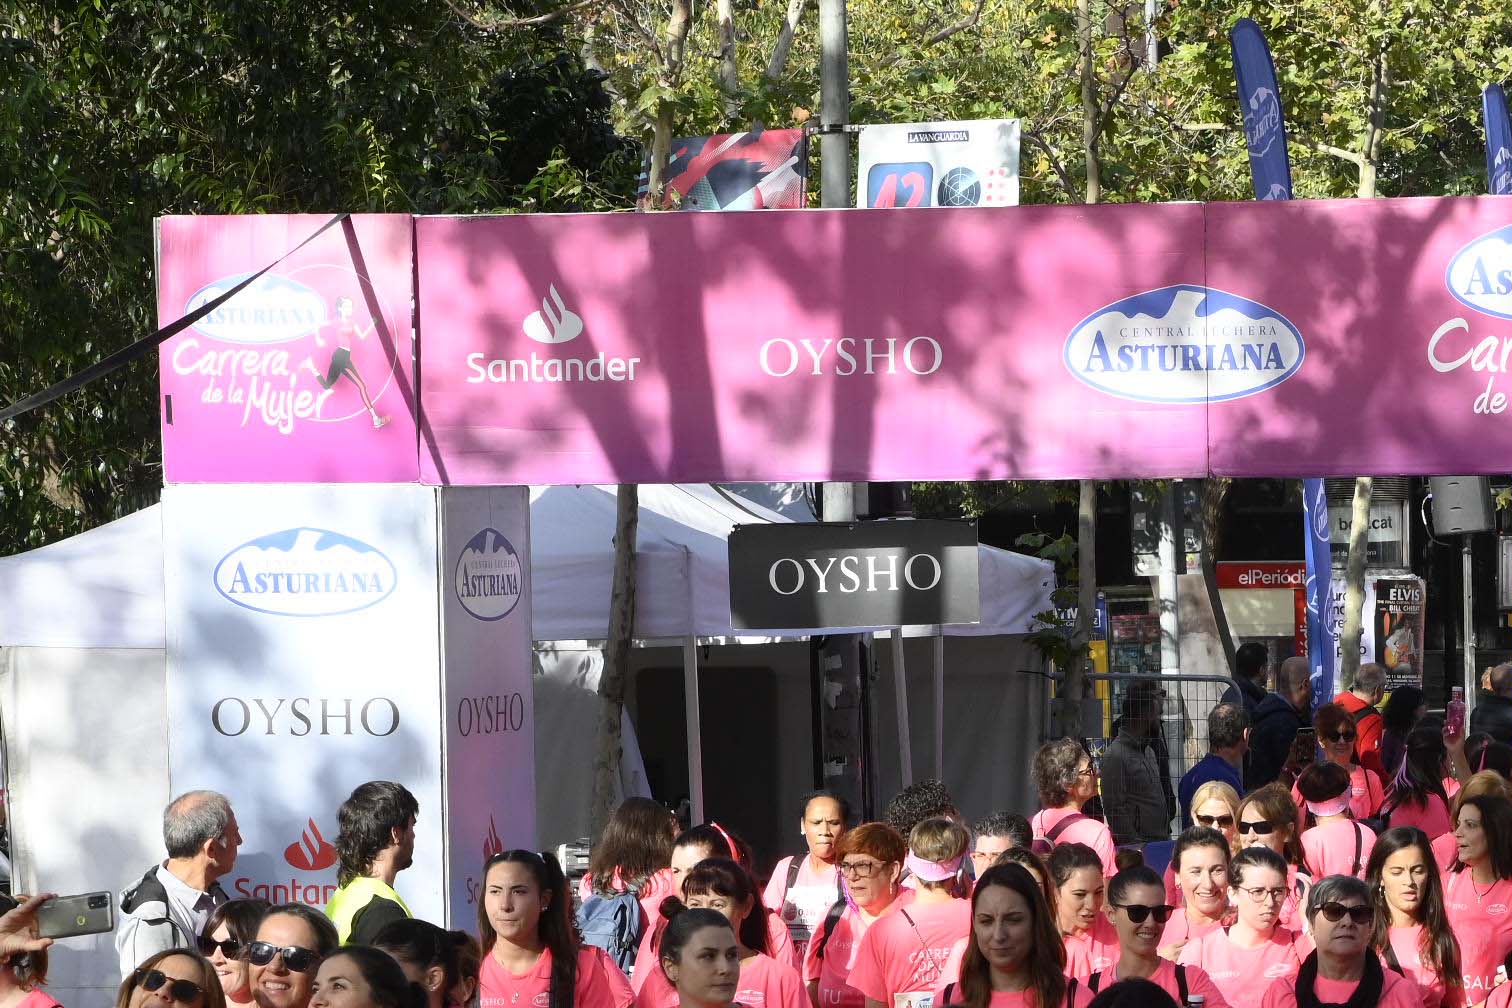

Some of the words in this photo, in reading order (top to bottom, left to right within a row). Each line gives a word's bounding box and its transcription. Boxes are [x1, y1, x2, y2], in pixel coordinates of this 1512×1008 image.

[921, 131, 969, 142] VANGUARDIA
[1119, 326, 1194, 339] CENTRAL
[172, 338, 290, 376] Carrera
[466, 352, 641, 385] Santander
[759, 336, 944, 377] OYSHO
[1083, 330, 1286, 373] ASTURIANA
[200, 377, 223, 404] de
[227, 377, 244, 405] la
[241, 374, 335, 436] Mujer
[1473, 378, 1506, 415] de
[228, 560, 383, 594] ASTURIANA
[460, 562, 519, 598] ASTURIANA
[769, 553, 942, 595] OYSHO
[1238, 569, 1307, 586] elPeriódi
[1389, 588, 1420, 601] ELVIS
[211, 697, 401, 737] OYSHO
[457, 692, 524, 738] OYSHO
[823, 989, 841, 1004] TU
[1463, 975, 1493, 991] SAL
